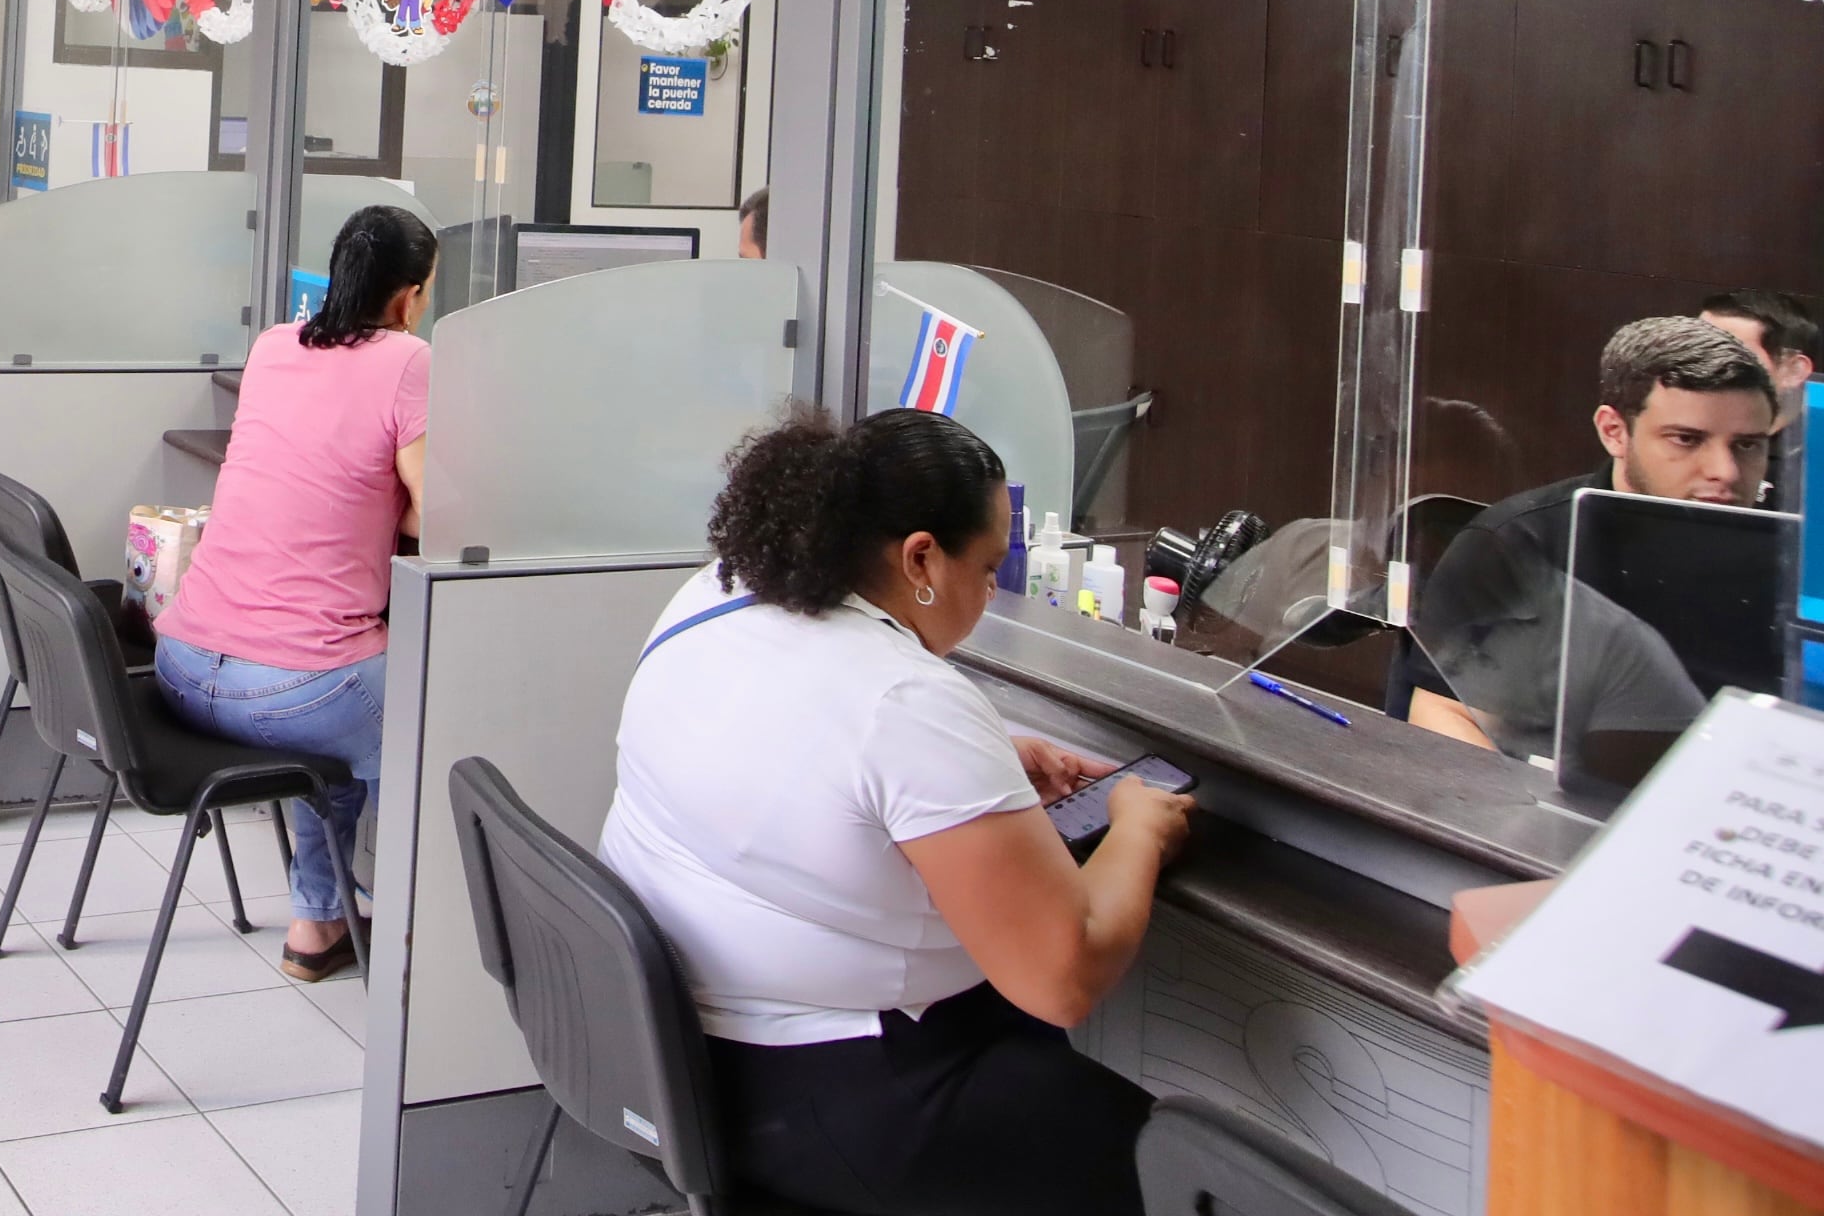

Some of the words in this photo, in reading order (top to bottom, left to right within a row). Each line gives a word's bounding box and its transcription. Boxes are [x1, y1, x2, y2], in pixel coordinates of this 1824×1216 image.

[649, 63, 680, 75] Favor
[649, 76, 702, 88] mantener
[648, 86, 660, 97] la
[662, 88, 698, 99] puerta
[647, 99, 692, 110] cerrada
[1725, 791, 1806, 825] PARA
[1738, 826, 1819, 860] DEBE
[1684, 840, 1774, 878] FICHA
[1680, 869, 1723, 893] DE
